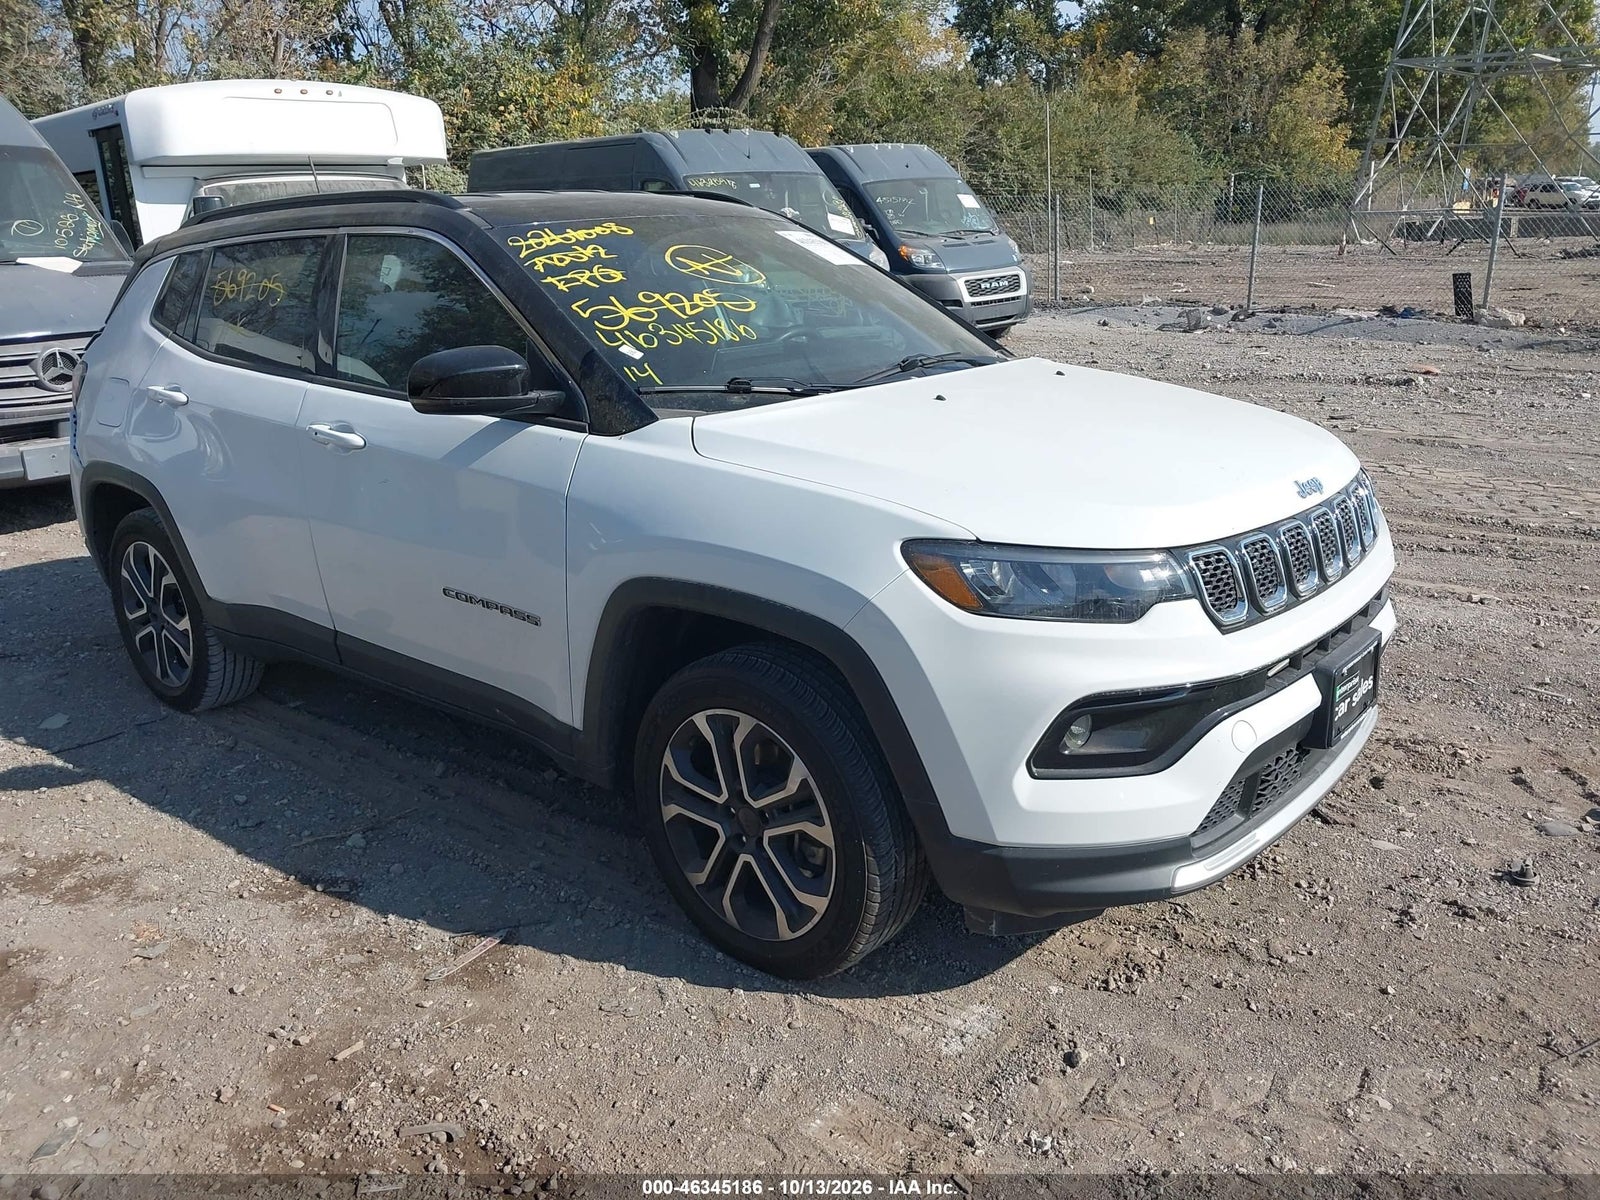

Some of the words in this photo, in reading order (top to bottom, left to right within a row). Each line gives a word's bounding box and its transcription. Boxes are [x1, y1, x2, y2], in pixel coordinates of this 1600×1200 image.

[210, 268, 288, 307] 569205
[980, 280, 1009, 289] RAM
[570, 288, 758, 331] 569205
[595, 318, 758, 350] 46345186
[623, 362, 664, 386] 14
[1294, 476, 1324, 499] Jeep
[442, 586, 542, 627] COMPASS
[1351, 675, 1374, 707] sales
